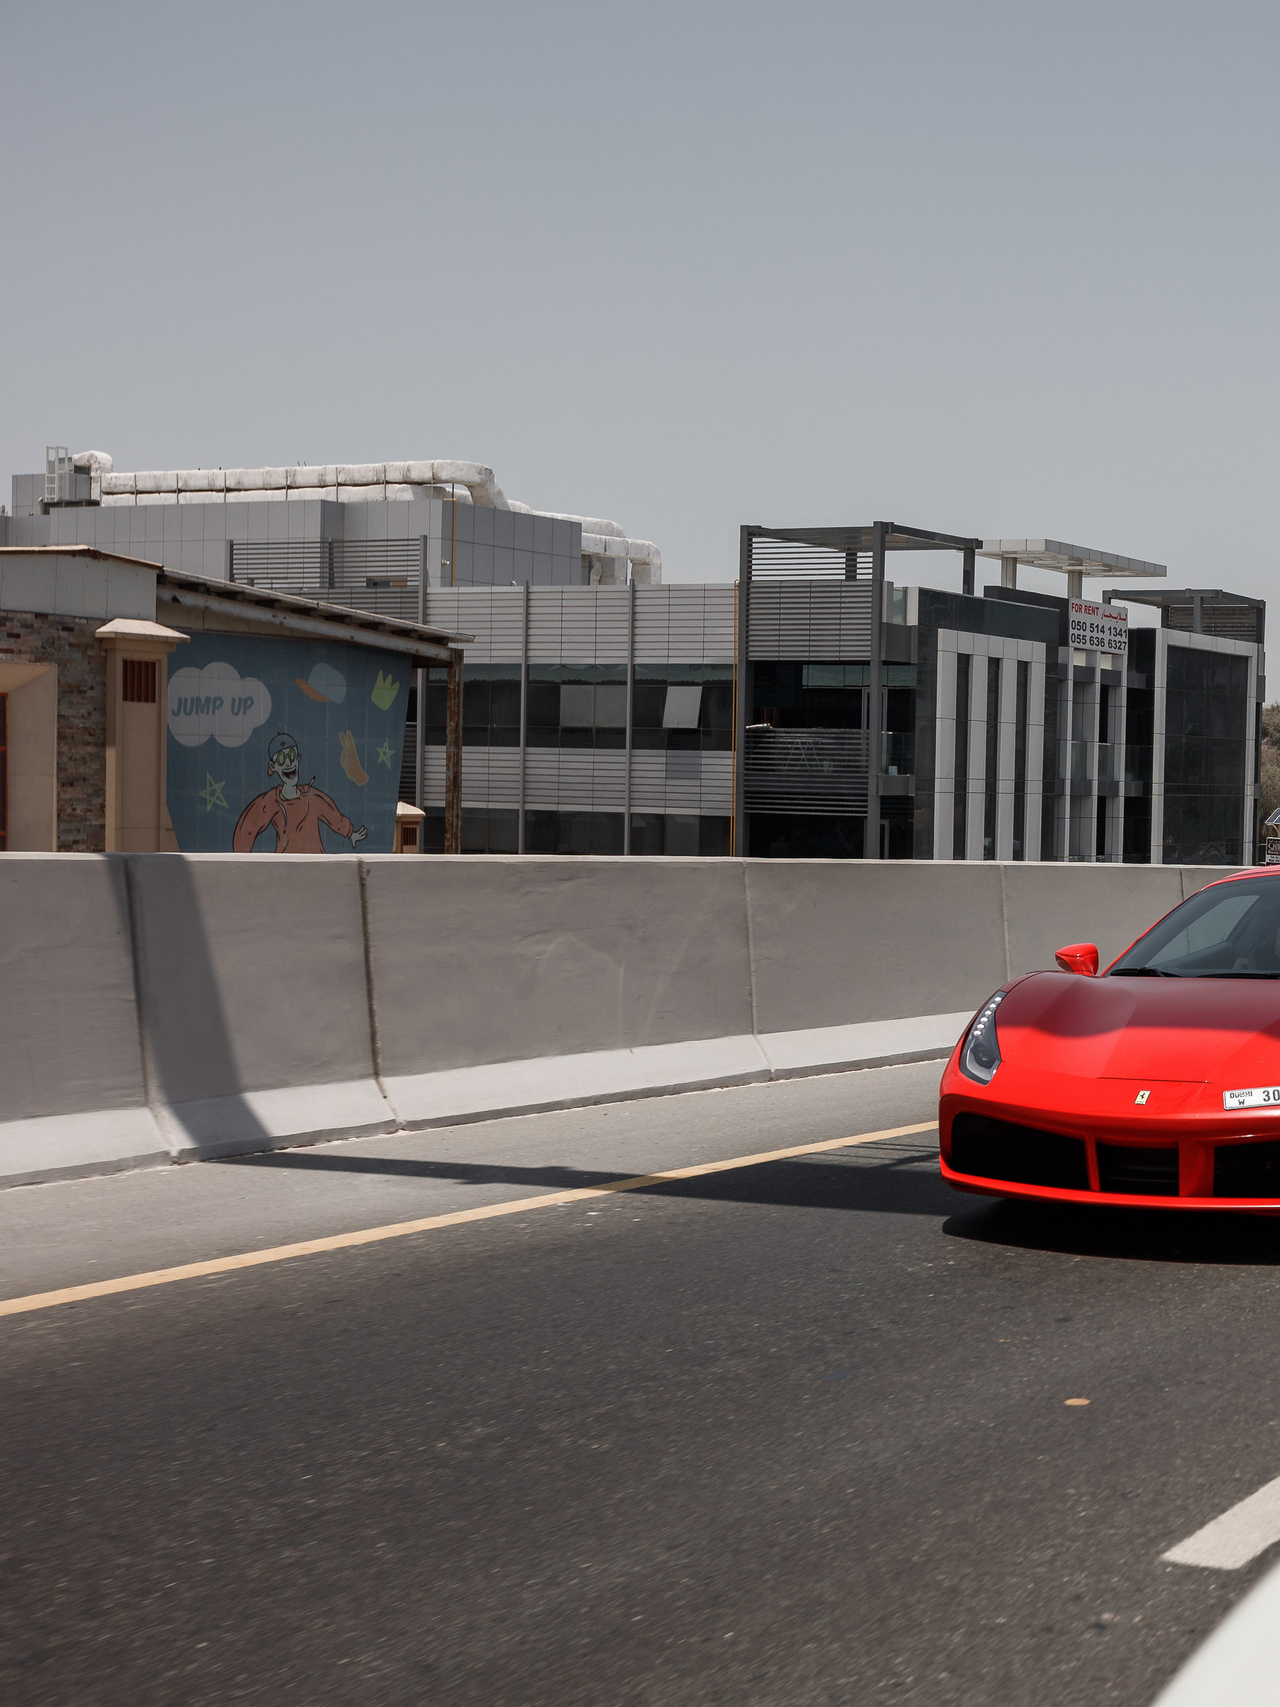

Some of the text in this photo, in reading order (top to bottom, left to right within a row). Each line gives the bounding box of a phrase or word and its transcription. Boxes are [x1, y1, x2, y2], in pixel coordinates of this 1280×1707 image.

[1071, 602, 1099, 616] FOR RENT
[1071, 619, 1127, 639] 050 514 1341
[1070, 632, 1127, 651] 055 636 6327
[171, 695, 255, 717] JUMP UP
